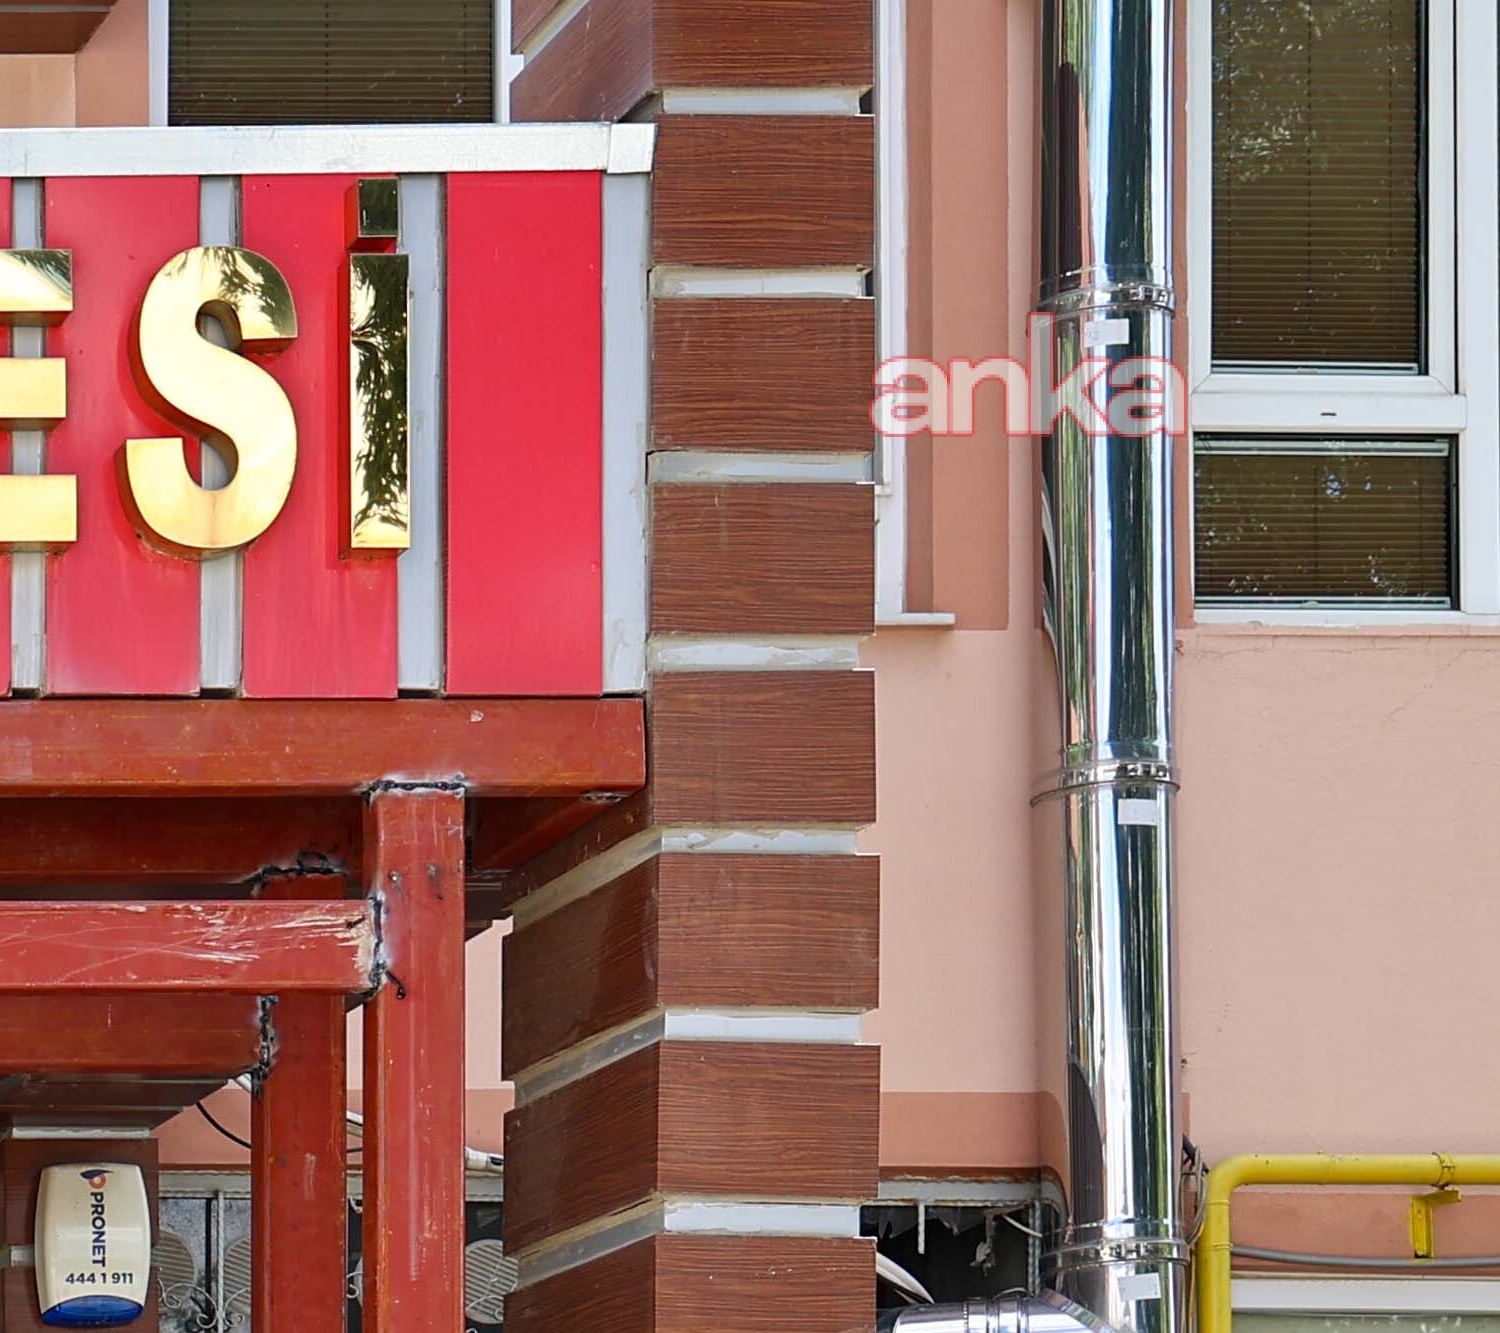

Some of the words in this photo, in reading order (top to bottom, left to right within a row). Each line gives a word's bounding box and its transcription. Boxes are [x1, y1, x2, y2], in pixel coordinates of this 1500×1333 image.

[89, 1191, 107, 1268] PRONET
[65, 1273, 97, 1284] 444
[100, 1273, 107, 1284] 1
[112, 1272, 134, 1284] 911
